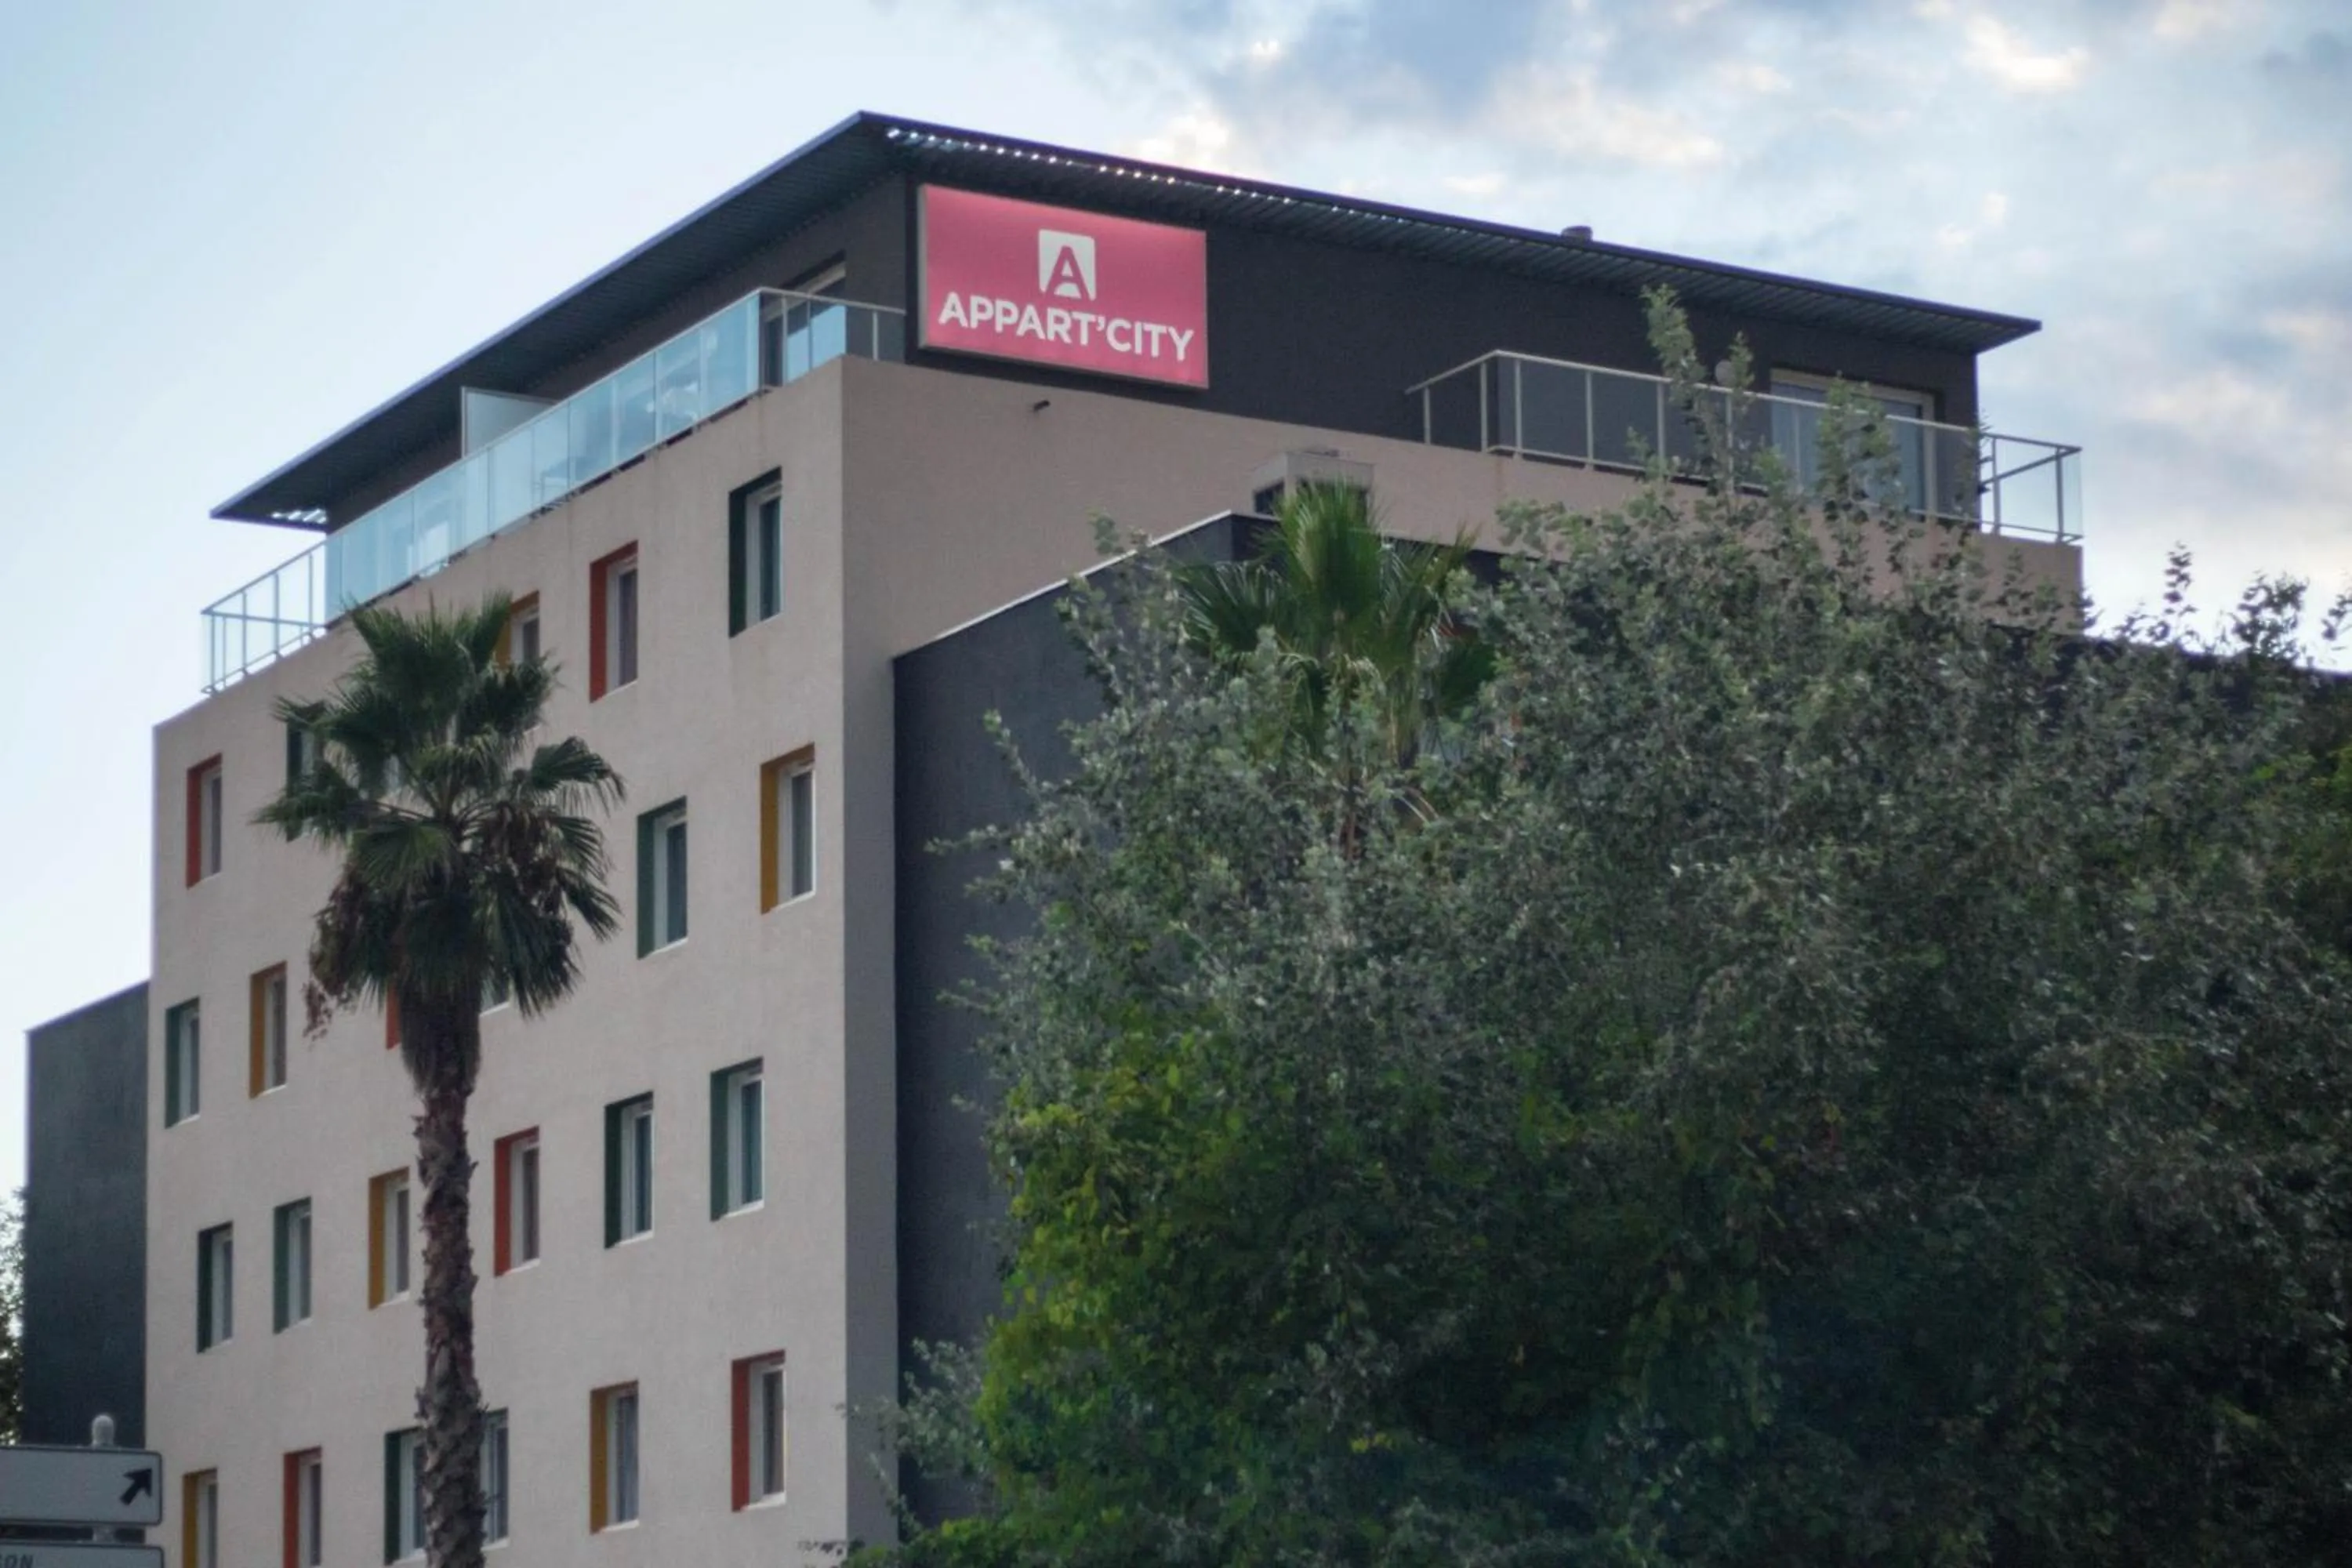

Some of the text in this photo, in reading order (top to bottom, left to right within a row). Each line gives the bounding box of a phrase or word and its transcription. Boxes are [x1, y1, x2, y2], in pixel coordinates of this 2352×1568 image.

[1043, 241, 1093, 300] A
[939, 292, 1194, 361] APPART'CITY
[0, 1554, 34, 1568] ON
